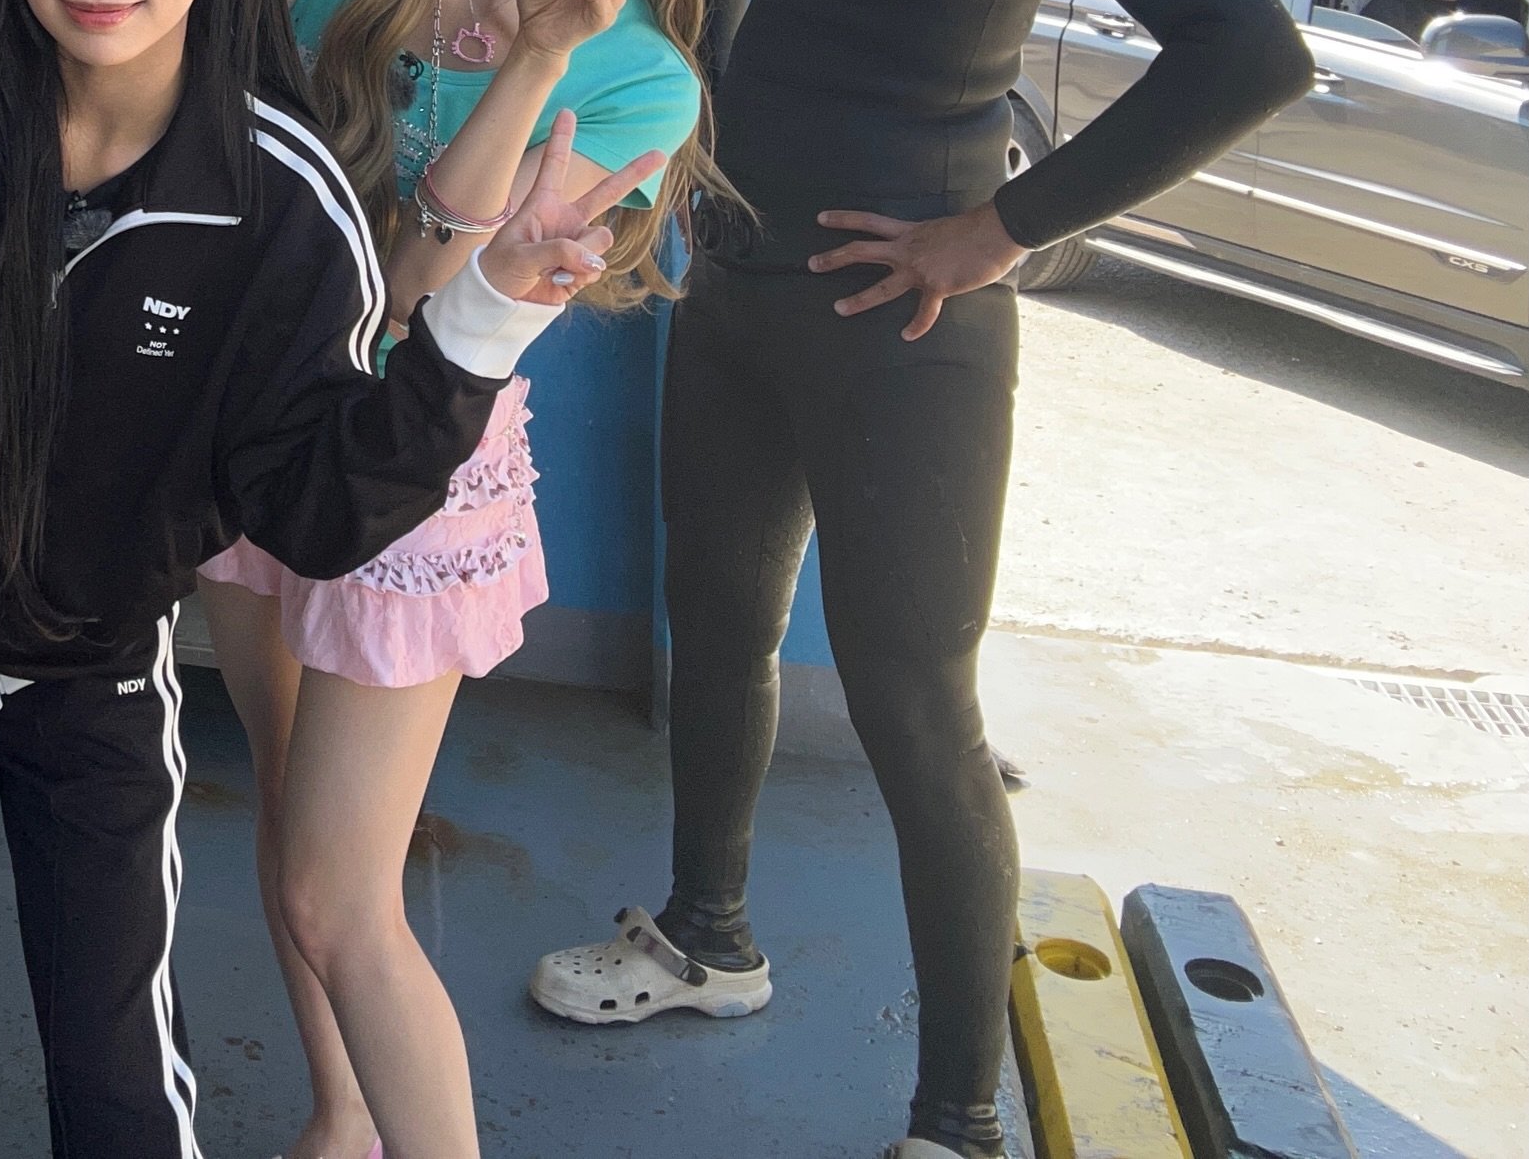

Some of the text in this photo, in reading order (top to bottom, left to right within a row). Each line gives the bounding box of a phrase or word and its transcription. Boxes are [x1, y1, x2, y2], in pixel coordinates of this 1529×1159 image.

[142, 296, 192, 320] NDY
[149, 340, 168, 349] NOT
[117, 677, 146, 695] NDY
